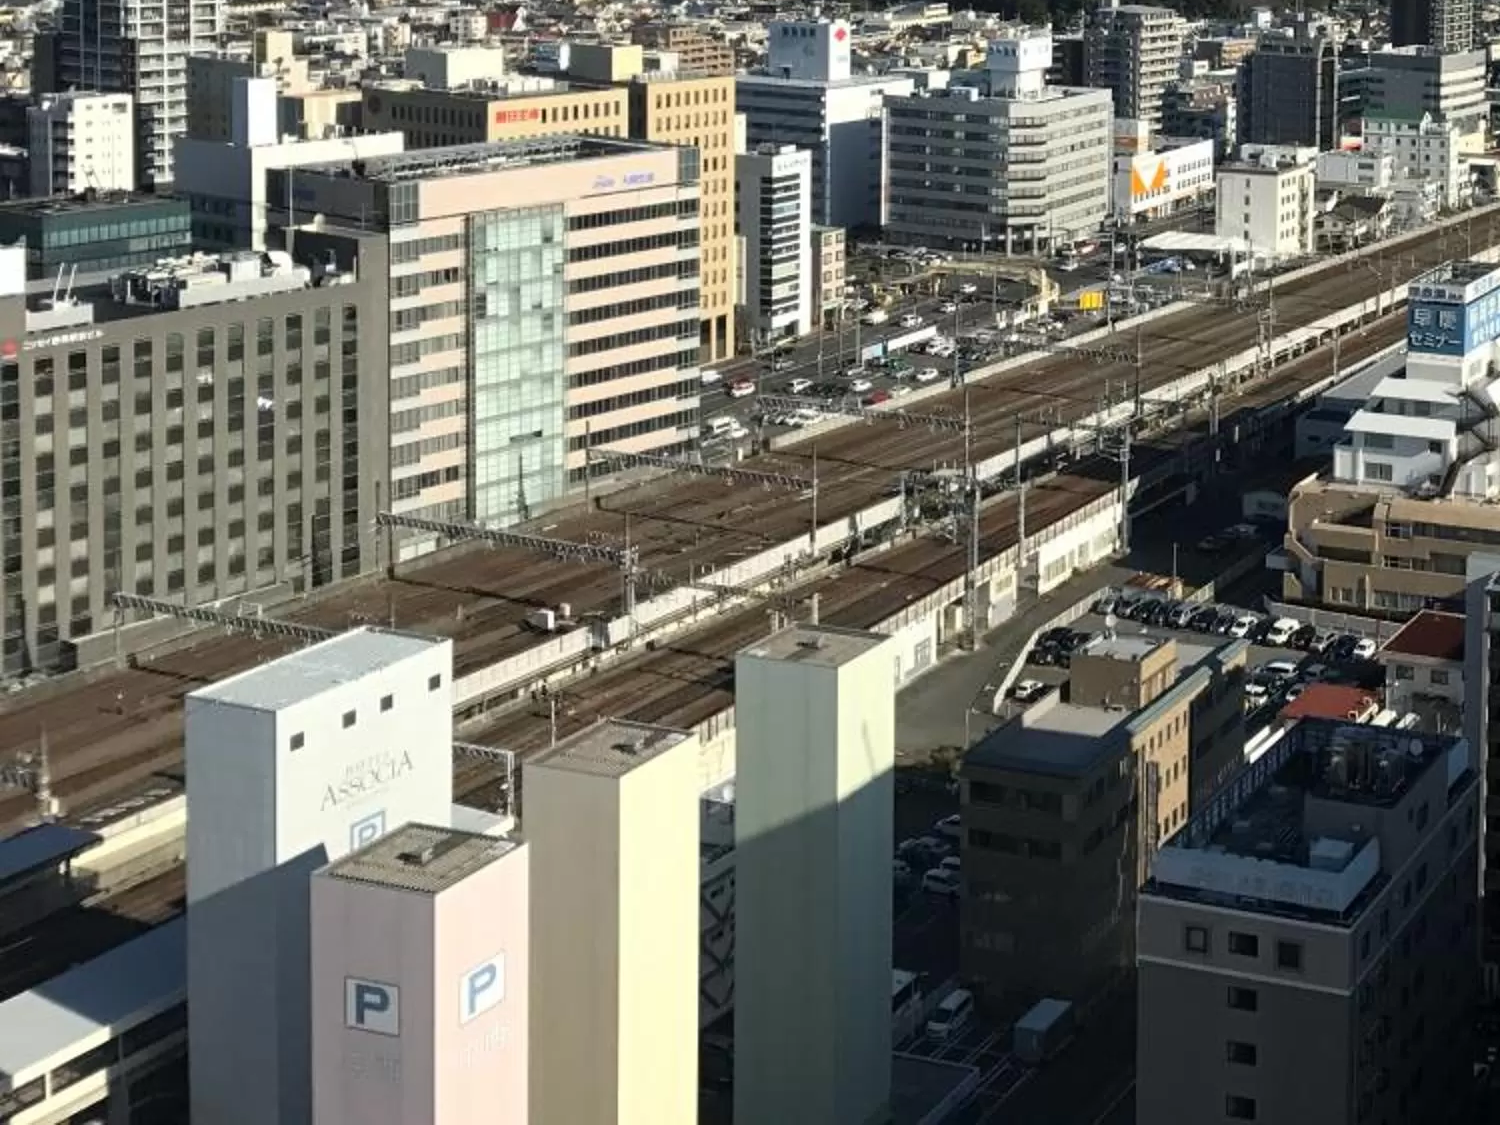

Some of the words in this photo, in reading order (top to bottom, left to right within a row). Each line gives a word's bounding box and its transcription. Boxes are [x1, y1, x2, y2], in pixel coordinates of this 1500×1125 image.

[1410, 331, 1462, 348] セミナー
[320, 750, 413, 811] ASSOCIA
[355, 983, 390, 1025] P
[468, 963, 497, 1016] P
